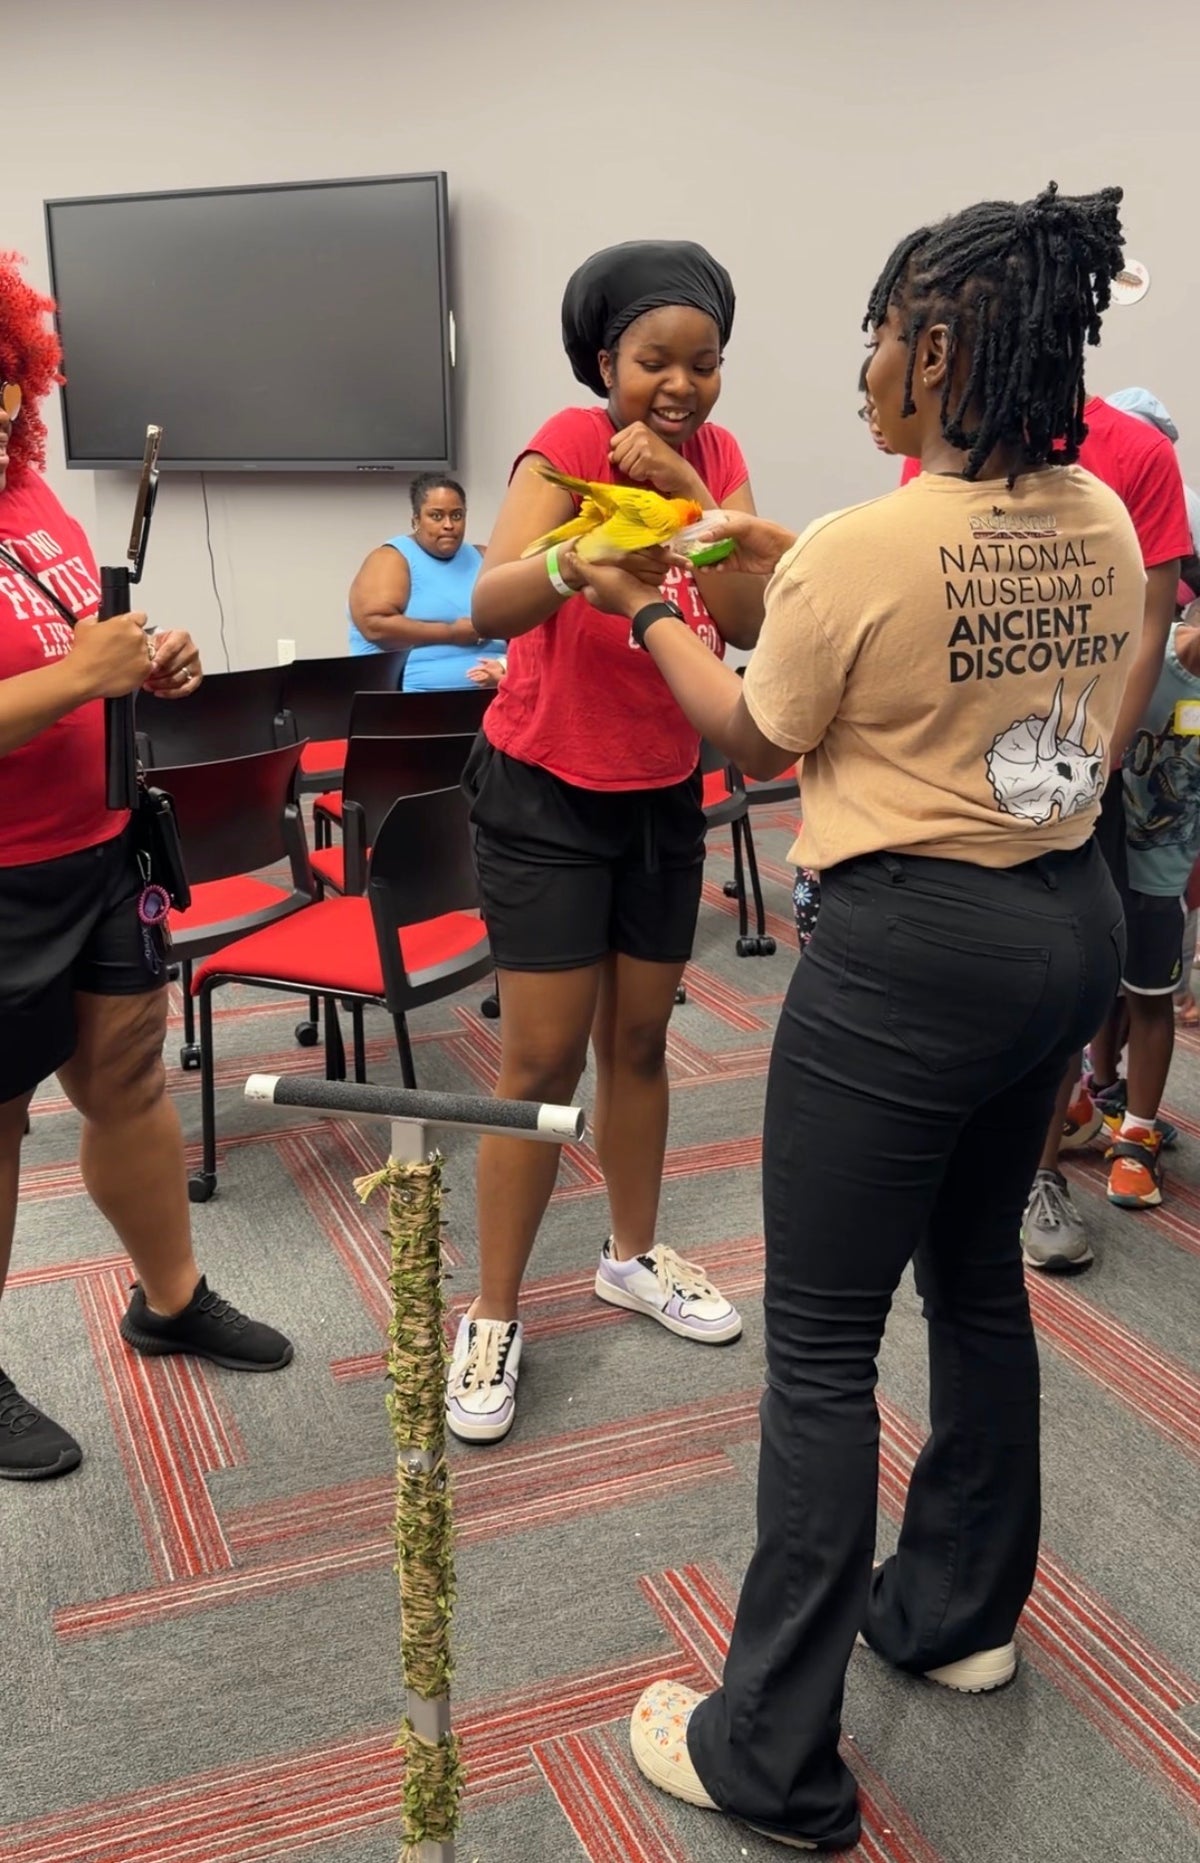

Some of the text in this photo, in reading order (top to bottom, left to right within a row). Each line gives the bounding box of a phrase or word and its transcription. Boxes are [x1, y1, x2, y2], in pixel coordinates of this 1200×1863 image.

[939, 539, 1096, 575] NATIONAL
[945, 567, 1115, 610] MUSEUM of
[947, 604, 1092, 648] ANCIENT
[949, 631, 1130, 683] DISCOVERY
